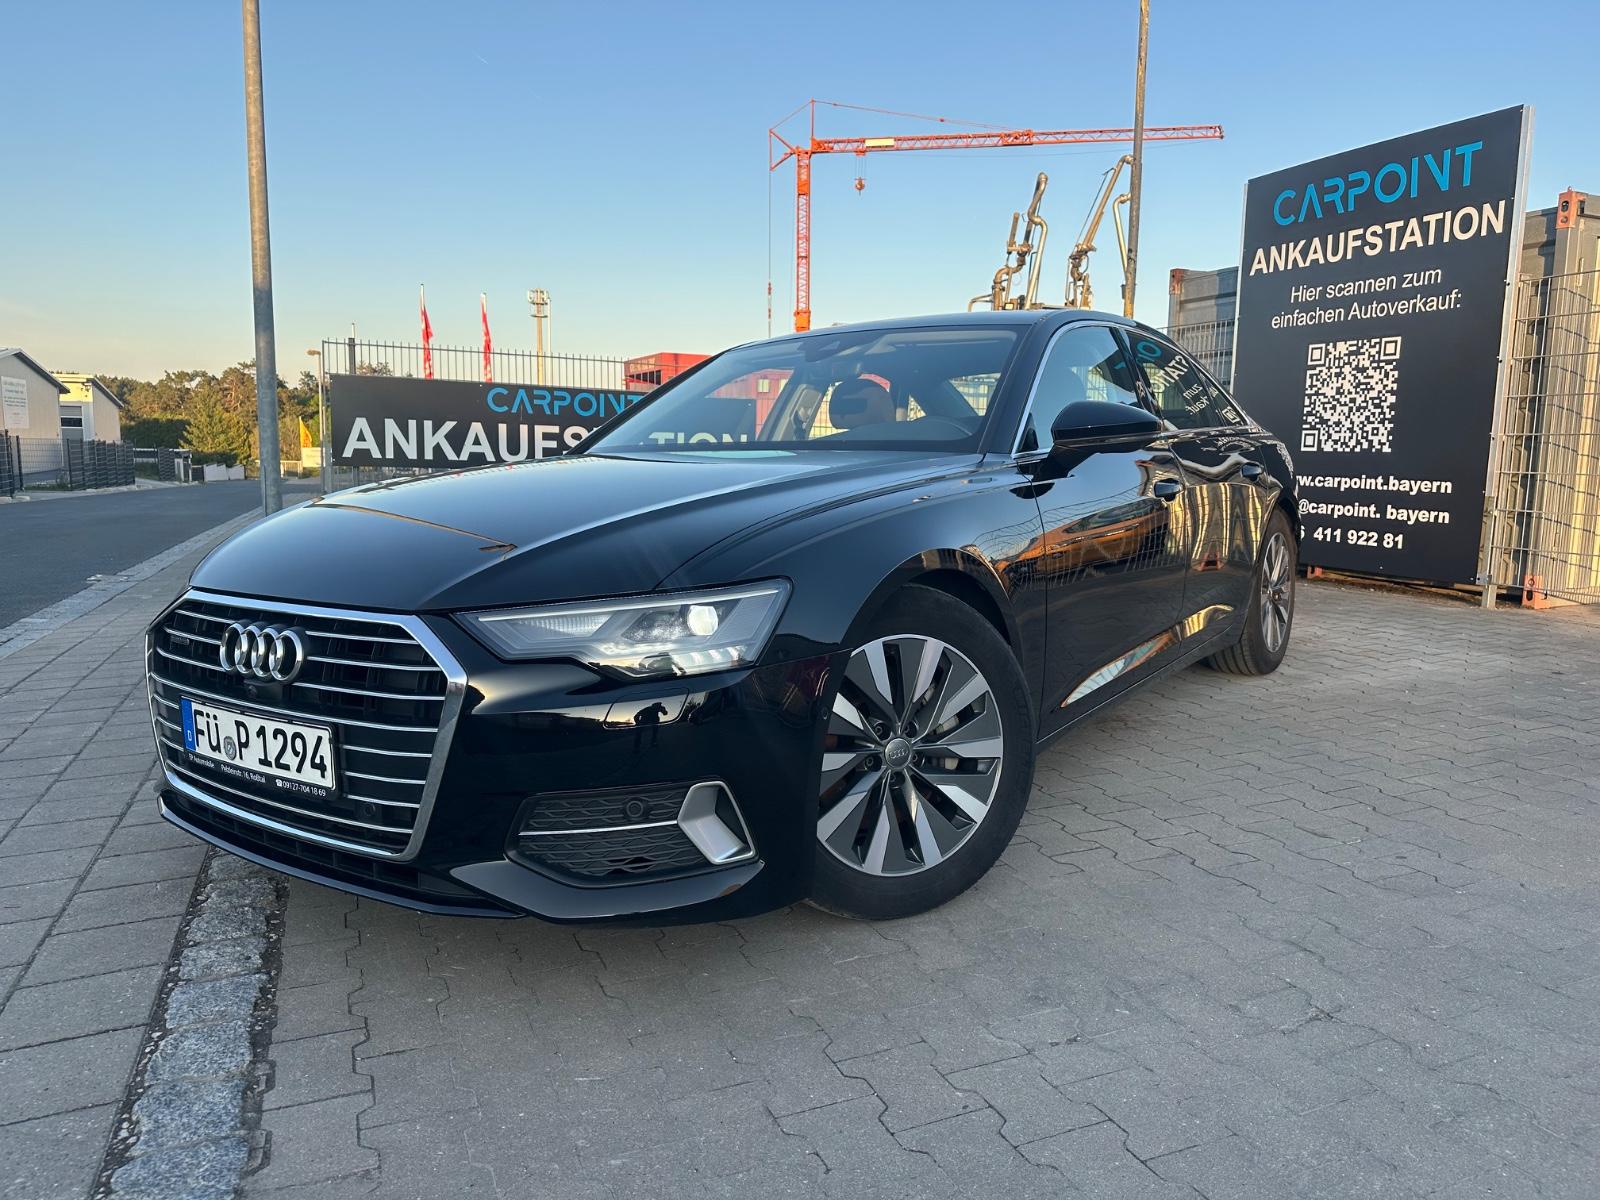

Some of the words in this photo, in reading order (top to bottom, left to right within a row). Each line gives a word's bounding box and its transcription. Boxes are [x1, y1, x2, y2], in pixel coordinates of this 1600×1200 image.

[1272, 140, 1483, 226] CARPOINT
[1249, 200, 1506, 276] ANKAUFSTATION
[1290, 284, 1323, 303] Hier
[1325, 275, 1397, 300] scannen
[1401, 269, 1442, 288] zum
[1271, 303, 1344, 329] einfachen
[1348, 289, 1462, 321] Autoverkauf:
[1296, 475, 1453, 496] w.carpoint.bayern
[1386, 504, 1450, 525] bayern
[1313, 526, 1342, 543] 411
[1347, 529, 1378, 547] 922
[1382, 533, 1404, 549] 81
[193, 709, 222, 754] FÜ
